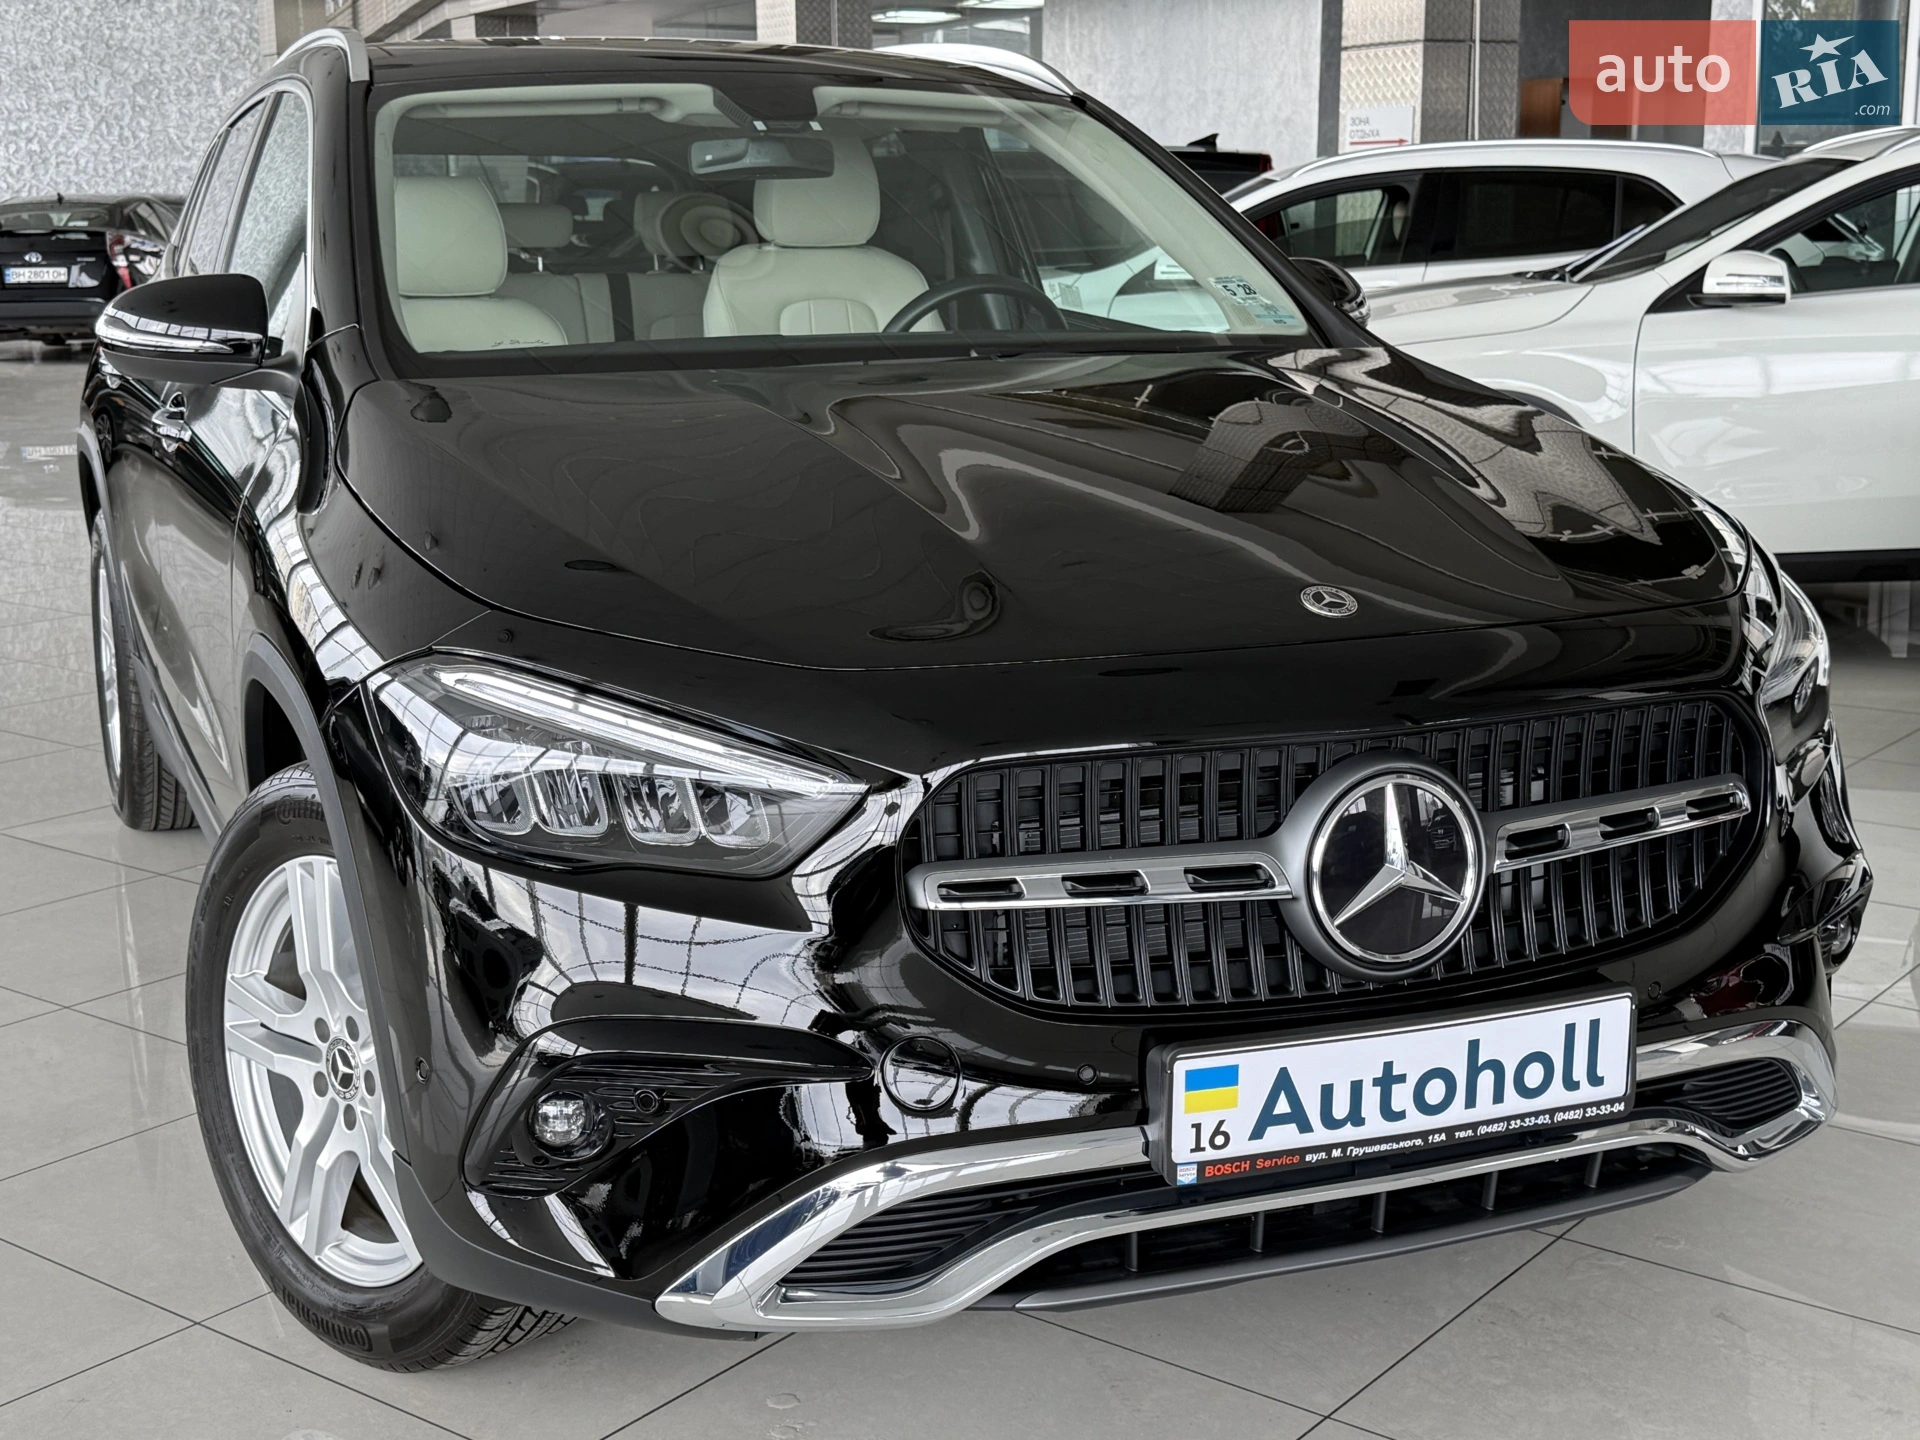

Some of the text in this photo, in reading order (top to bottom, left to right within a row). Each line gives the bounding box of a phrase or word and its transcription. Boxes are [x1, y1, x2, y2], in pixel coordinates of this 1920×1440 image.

[28, 270, 50, 280] 2801
[1222, 283, 1257, 297] 5 28
[1247, 1017, 1605, 1142] Autoholl
[1189, 1119, 1231, 1154] 16
[1305, 1152, 1329, 1163] вул.
[1331, 1148, 1344, 1159] М.
[1346, 1138, 1424, 1158] Грушевського,
[1454, 1130, 1475, 1139] тел.
[1477, 1121, 1508, 1136] (0482)
[1509, 1114, 1552, 1130] 33-33-03,
[1554, 1107, 1583, 1123] (0482)
[1585, 1101, 1626, 1117] 33-33-04
[1204, 1154, 1300, 1178] BOSCH Service
[281, 1284, 374, 1353] Continental
